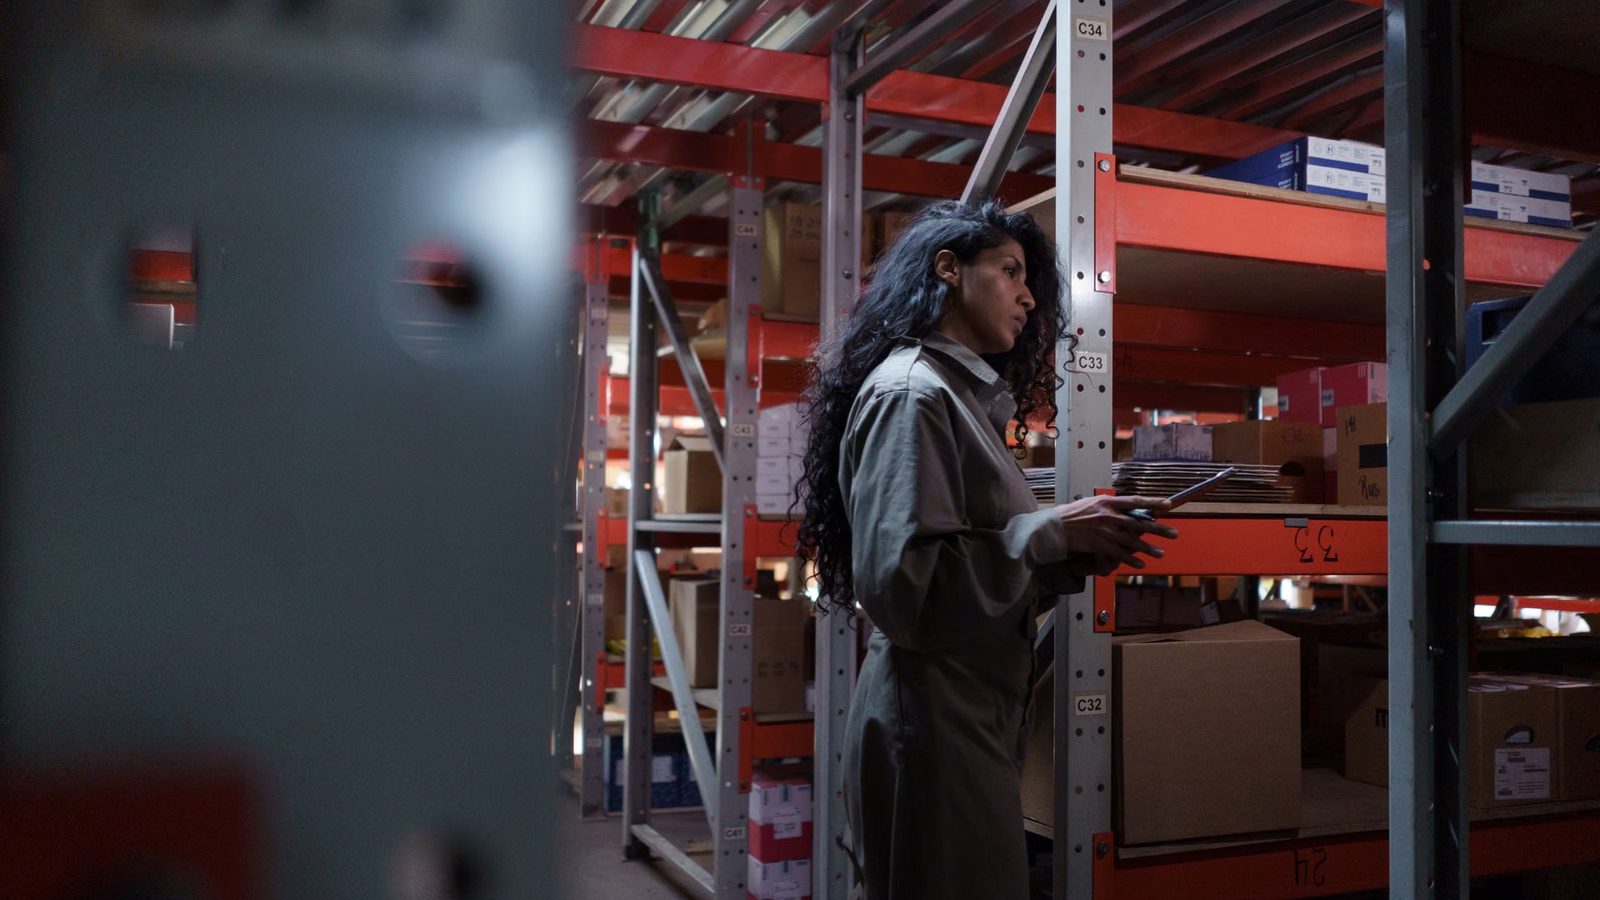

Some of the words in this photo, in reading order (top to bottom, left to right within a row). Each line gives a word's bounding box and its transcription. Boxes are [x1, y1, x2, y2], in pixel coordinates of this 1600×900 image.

[1078, 22, 1102, 37] C34
[1079, 356, 1103, 369] C33
[1358, 475, 1380, 500] Rus
[1294, 524, 1339, 563] 33
[731, 626, 748, 634] C42
[1077, 698, 1102, 711] C32
[726, 829, 742, 838] C41
